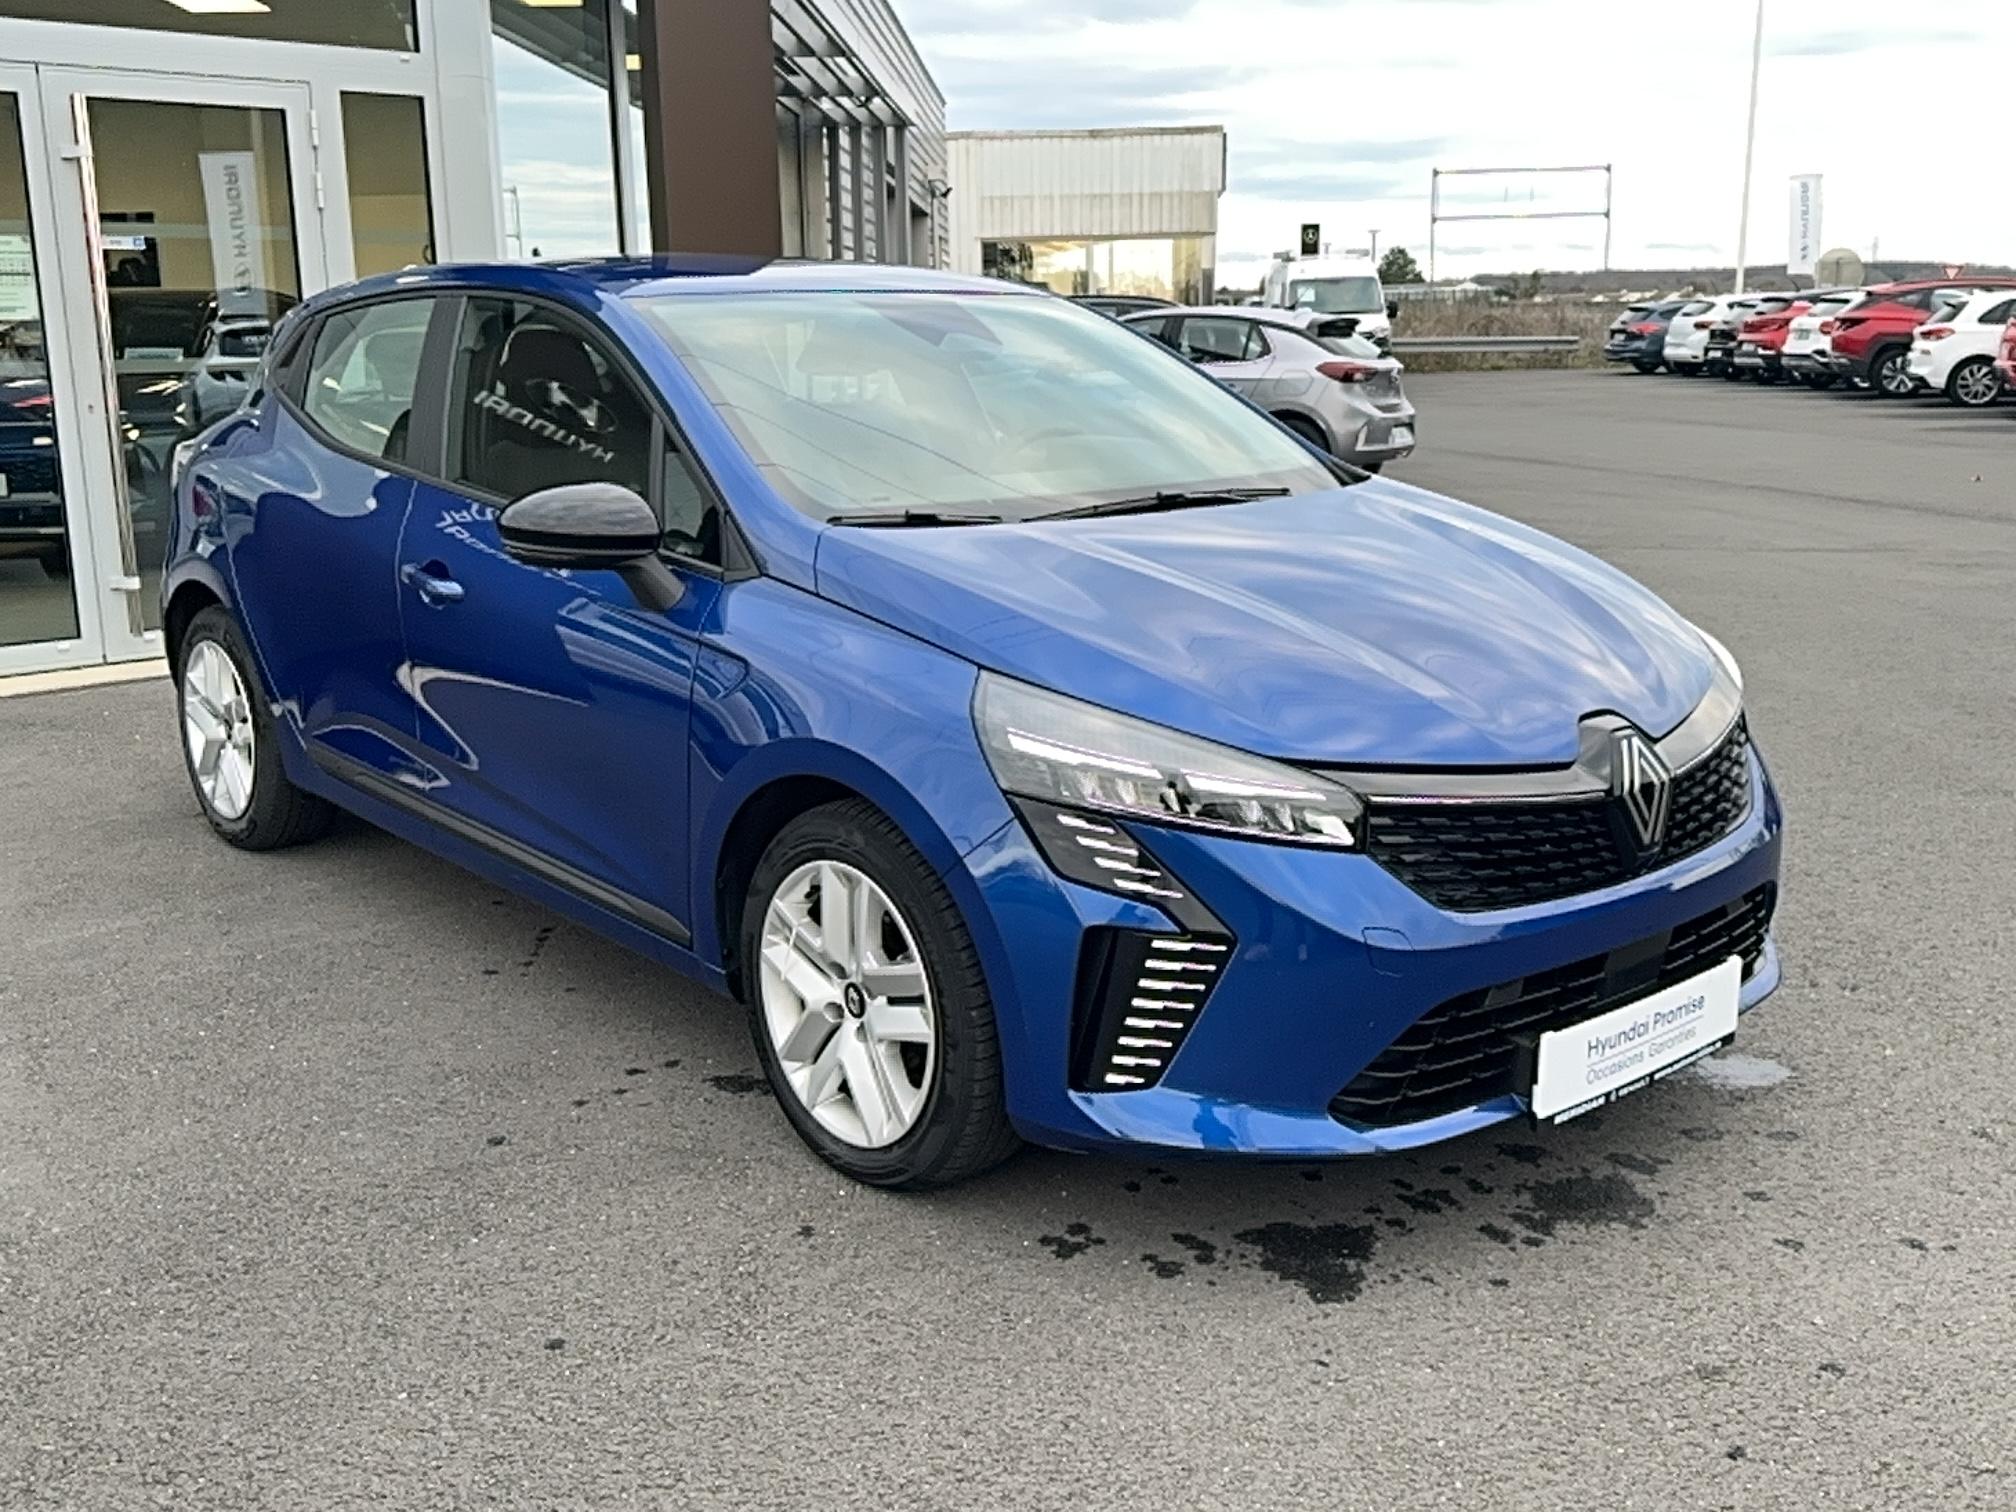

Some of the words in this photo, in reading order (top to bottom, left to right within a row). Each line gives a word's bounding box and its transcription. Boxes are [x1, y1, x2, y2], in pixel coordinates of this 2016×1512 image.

[1586, 1050, 1644, 1085] Occasions
[1648, 1026, 1697, 1058] Garanties
[1587, 1015, 1650, 1059] Hyundai
[1653, 994, 1705, 1030] Promise
